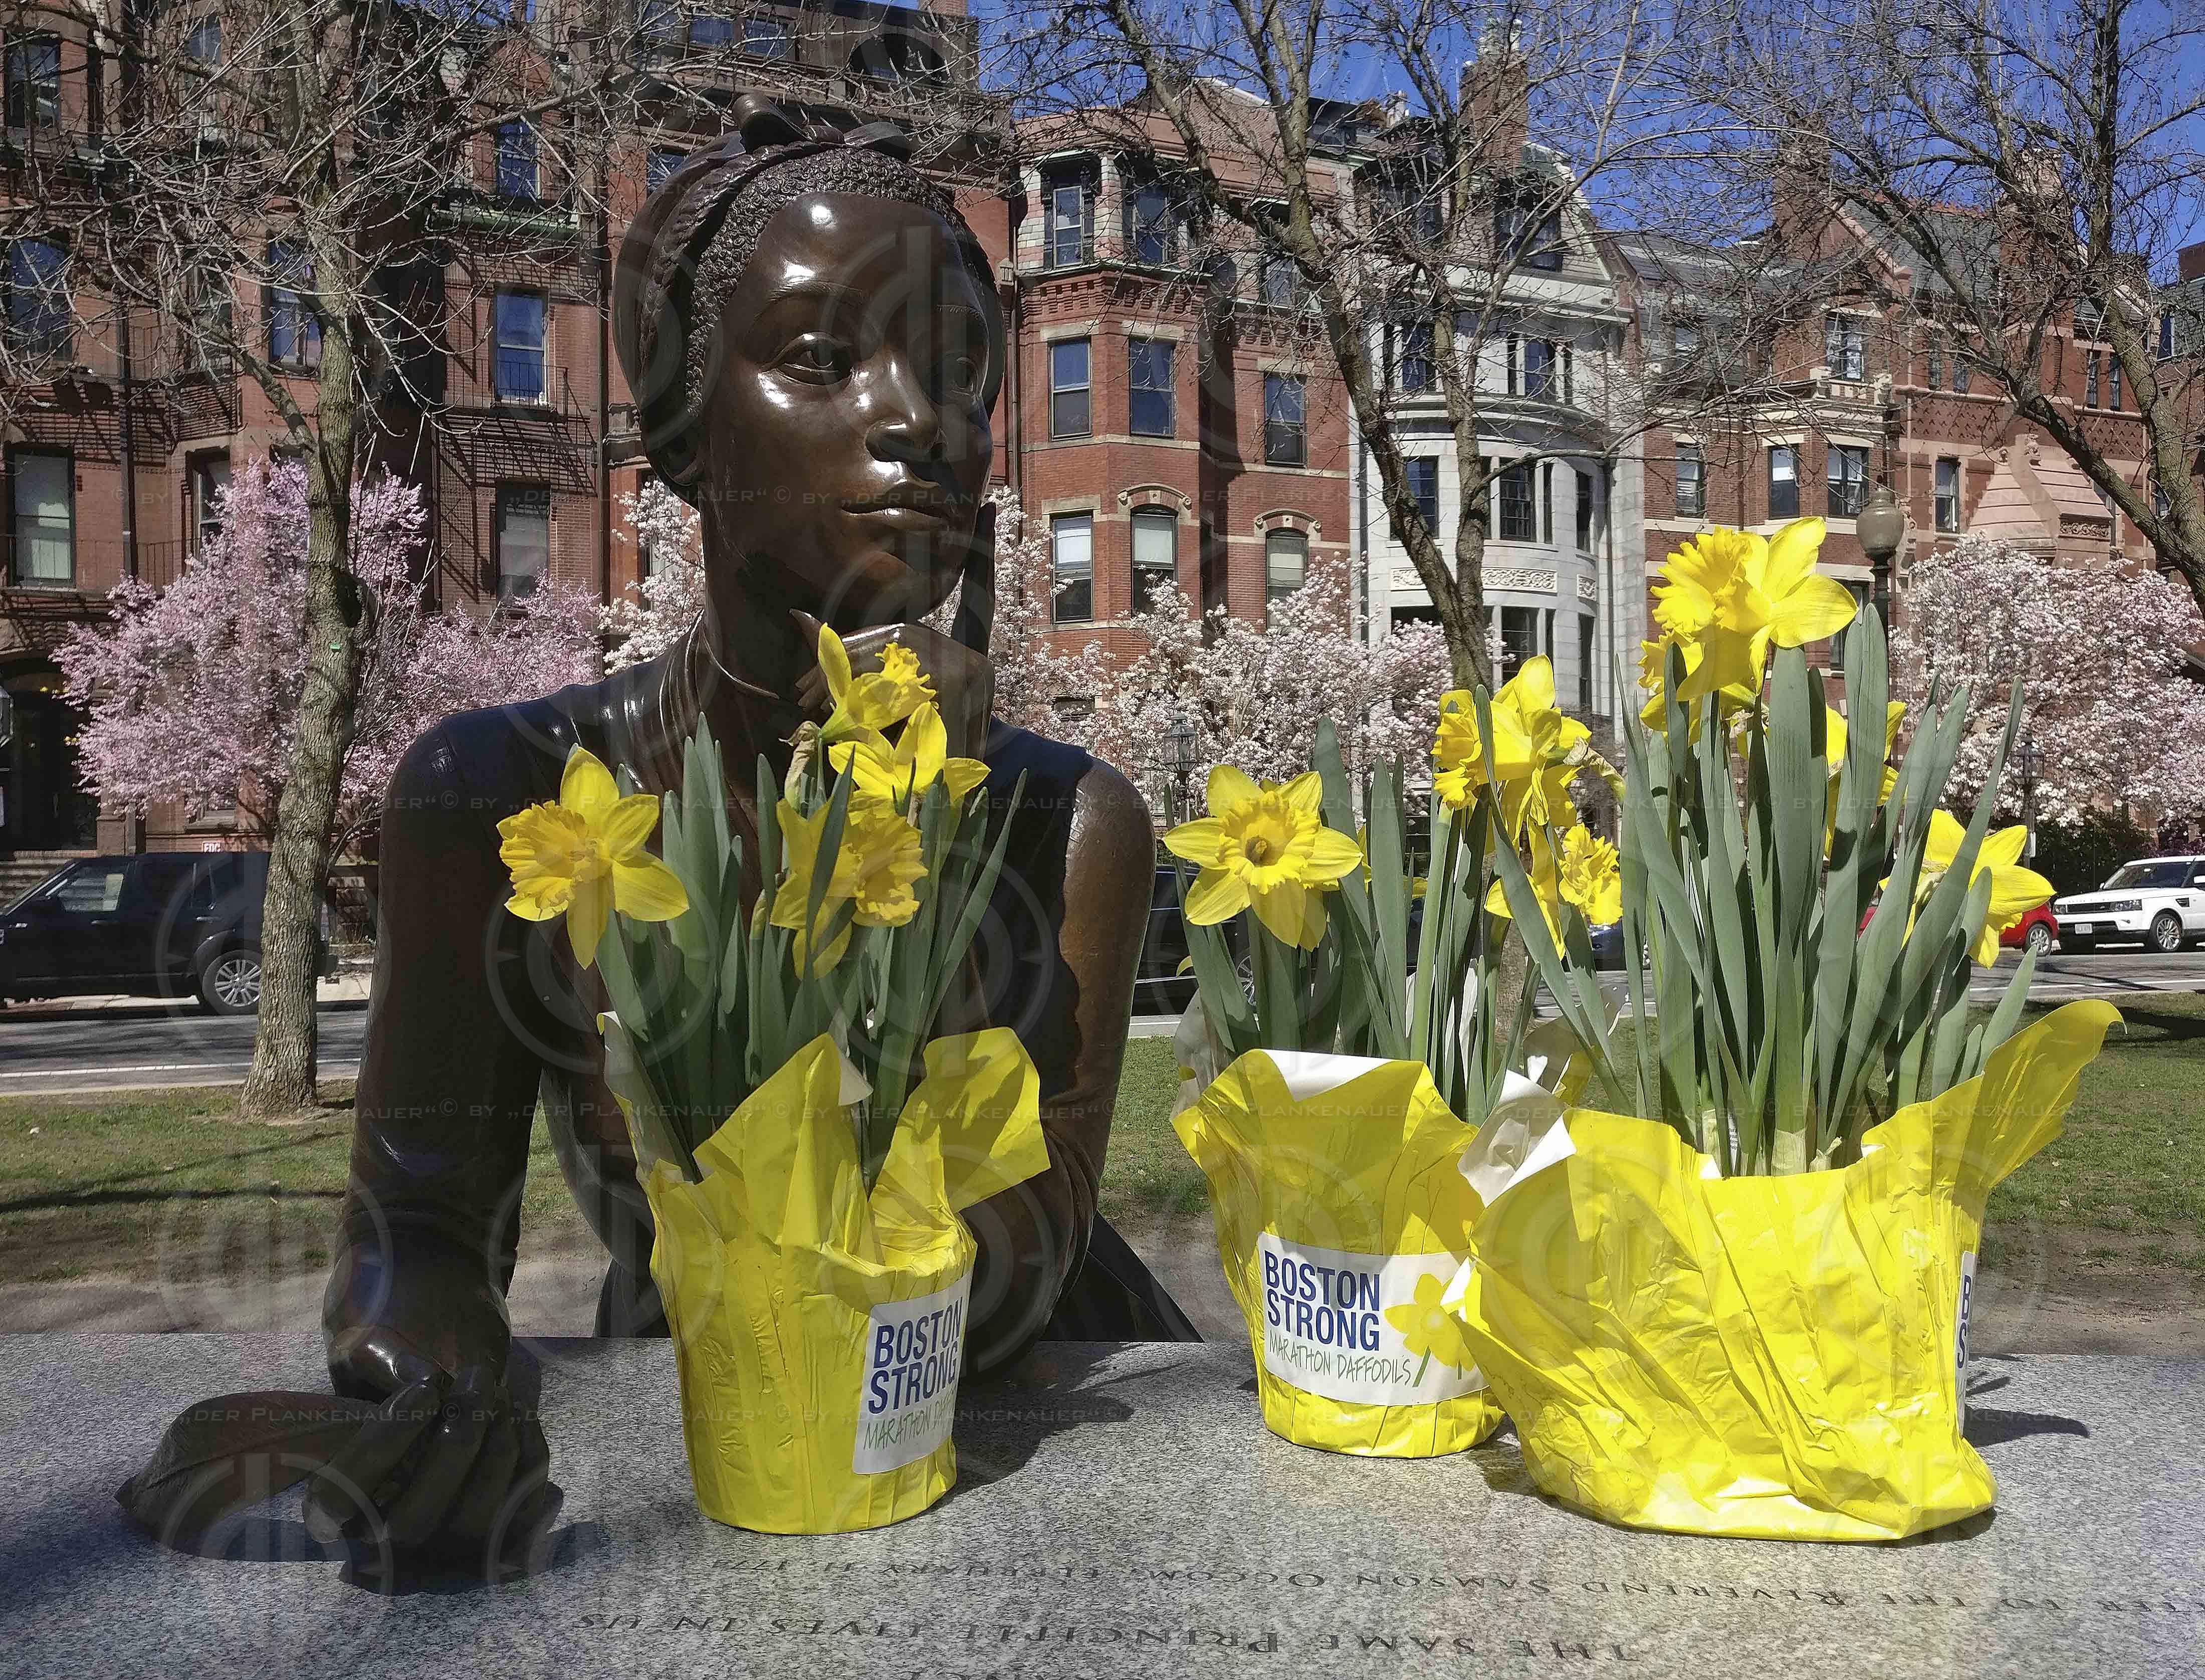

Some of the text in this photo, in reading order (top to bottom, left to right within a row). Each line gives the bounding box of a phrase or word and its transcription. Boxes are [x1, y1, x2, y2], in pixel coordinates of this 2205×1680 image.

[1264, 1250, 1380, 1311] BOSTON
[873, 1297, 963, 1368] BOSTON
[1267, 1290, 1380, 1351] STRONG
[868, 1341, 958, 1415] STRONG
[1269, 1330, 1411, 1386] MARATHON DAFFODILS
[863, 1402, 931, 1450] MARATHON
[1356, 1574, 1551, 1595] SAMSON
[568, 1613, 644, 1631] US
[670, 1615, 744, 1633] IN
[1316, 1633, 1474, 1656] SAME
[1509, 1639, 1640, 1662] THE
